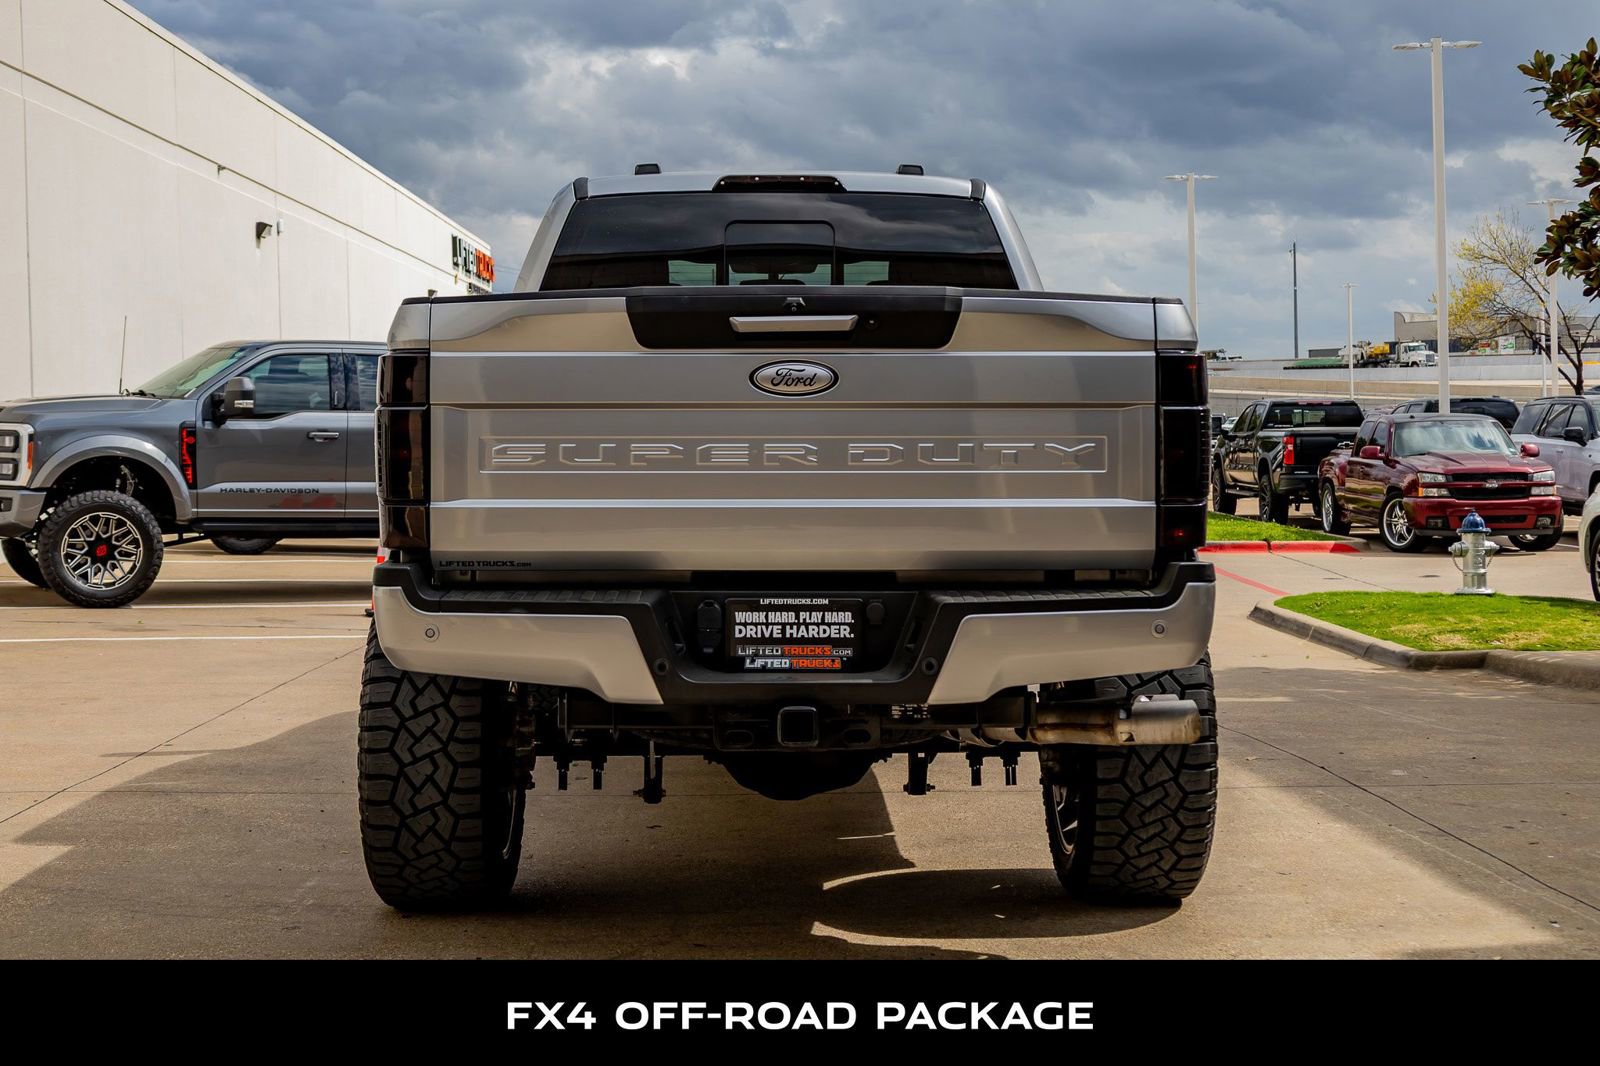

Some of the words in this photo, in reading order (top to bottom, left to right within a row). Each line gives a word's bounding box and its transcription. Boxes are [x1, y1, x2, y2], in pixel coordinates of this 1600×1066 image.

[770, 367, 818, 387] Ford
[492, 444, 818, 466] SUPER
[848, 443, 1096, 466] DUTY
[735, 611, 767, 623] WORK
[768, 611, 798, 623] HARD.
[800, 611, 824, 623] PLAY
[825, 611, 855, 623] HARD.
[735, 625, 782, 638] DRIVE
[786, 625, 855, 638] HARDER.
[738, 646, 781, 655] LIFTED
[745, 658, 789, 668] LIFTED
